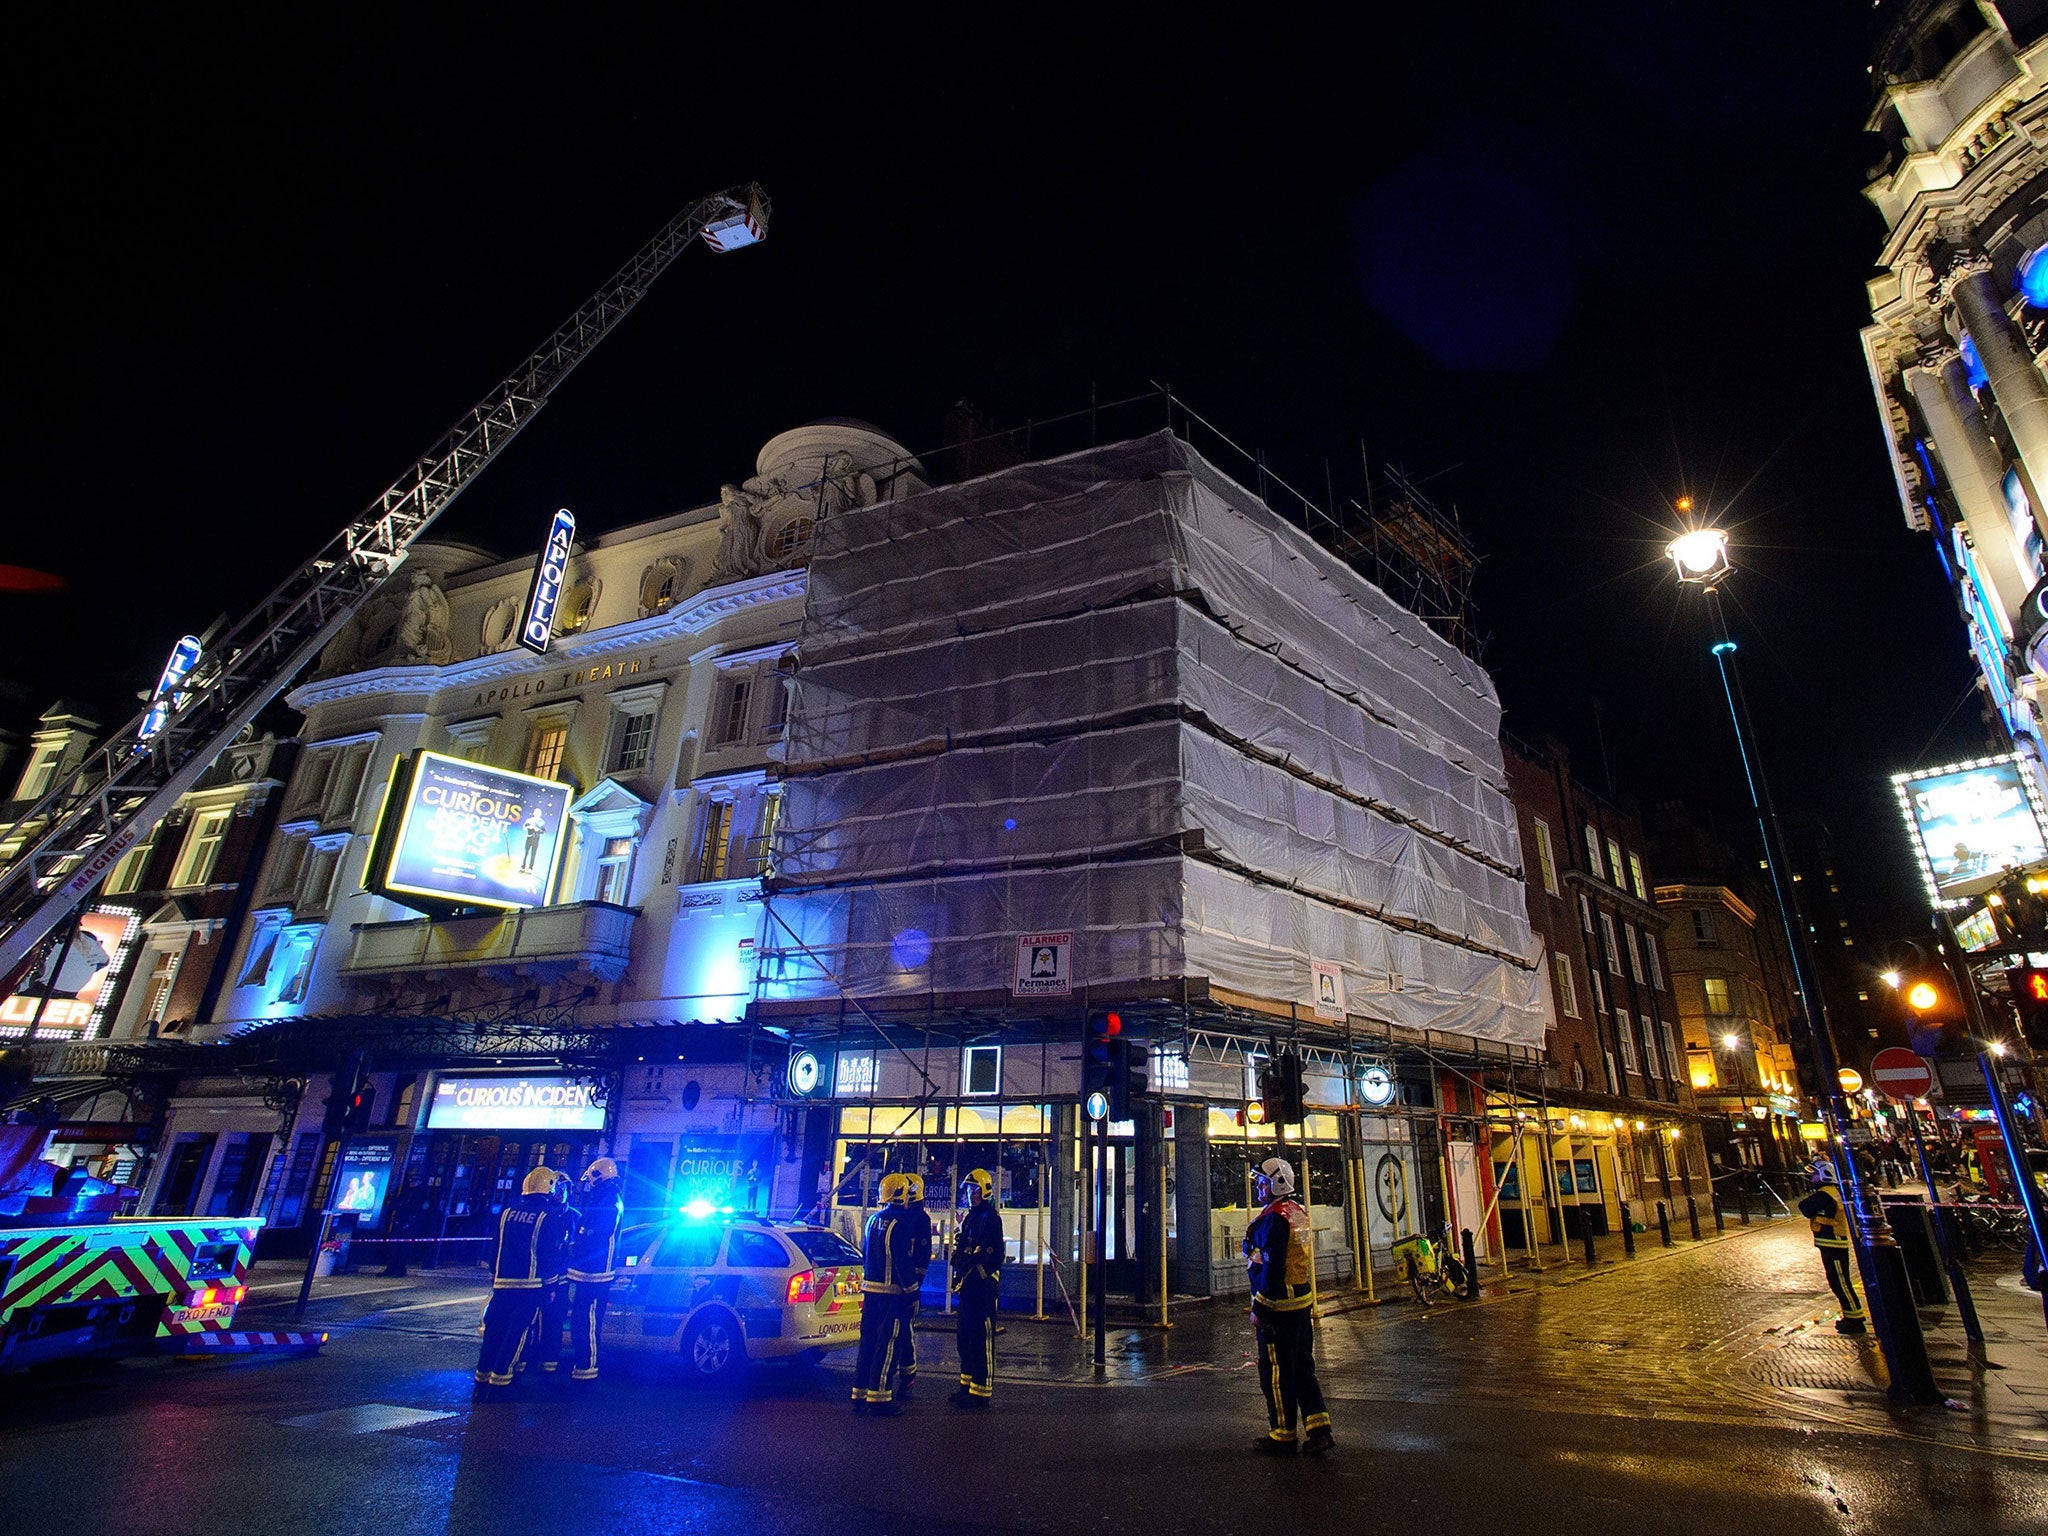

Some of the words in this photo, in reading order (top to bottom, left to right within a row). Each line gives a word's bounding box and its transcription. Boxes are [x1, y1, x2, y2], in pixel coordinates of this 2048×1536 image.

[528, 528, 568, 641] APOLLO
[474, 679, 545, 706] APOLLO
[562, 655, 658, 688] THEATRE
[422, 786, 522, 822] CURIOUS
[435, 807, 511, 834] INCIDENT
[72, 831, 136, 891] MAGIRUS
[1022, 935, 1069, 945] ALARMED
[1314, 962, 1339, 975] ALARMED
[1019, 978, 1067, 988] Permanex
[1, 996, 92, 1025] LLER
[1316, 1001, 1343, 1013] Permanex
[456, 1086, 523, 1107] CURIOUS
[681, 1159, 744, 1176] CURIOUS
[690, 1177, 733, 1190] INCIDEN
[924, 1186, 953, 1198] EASONS
[507, 1210, 537, 1224] FIRE
[178, 1308, 207, 1322] BX07
[818, 1322, 848, 1334] LONDON
